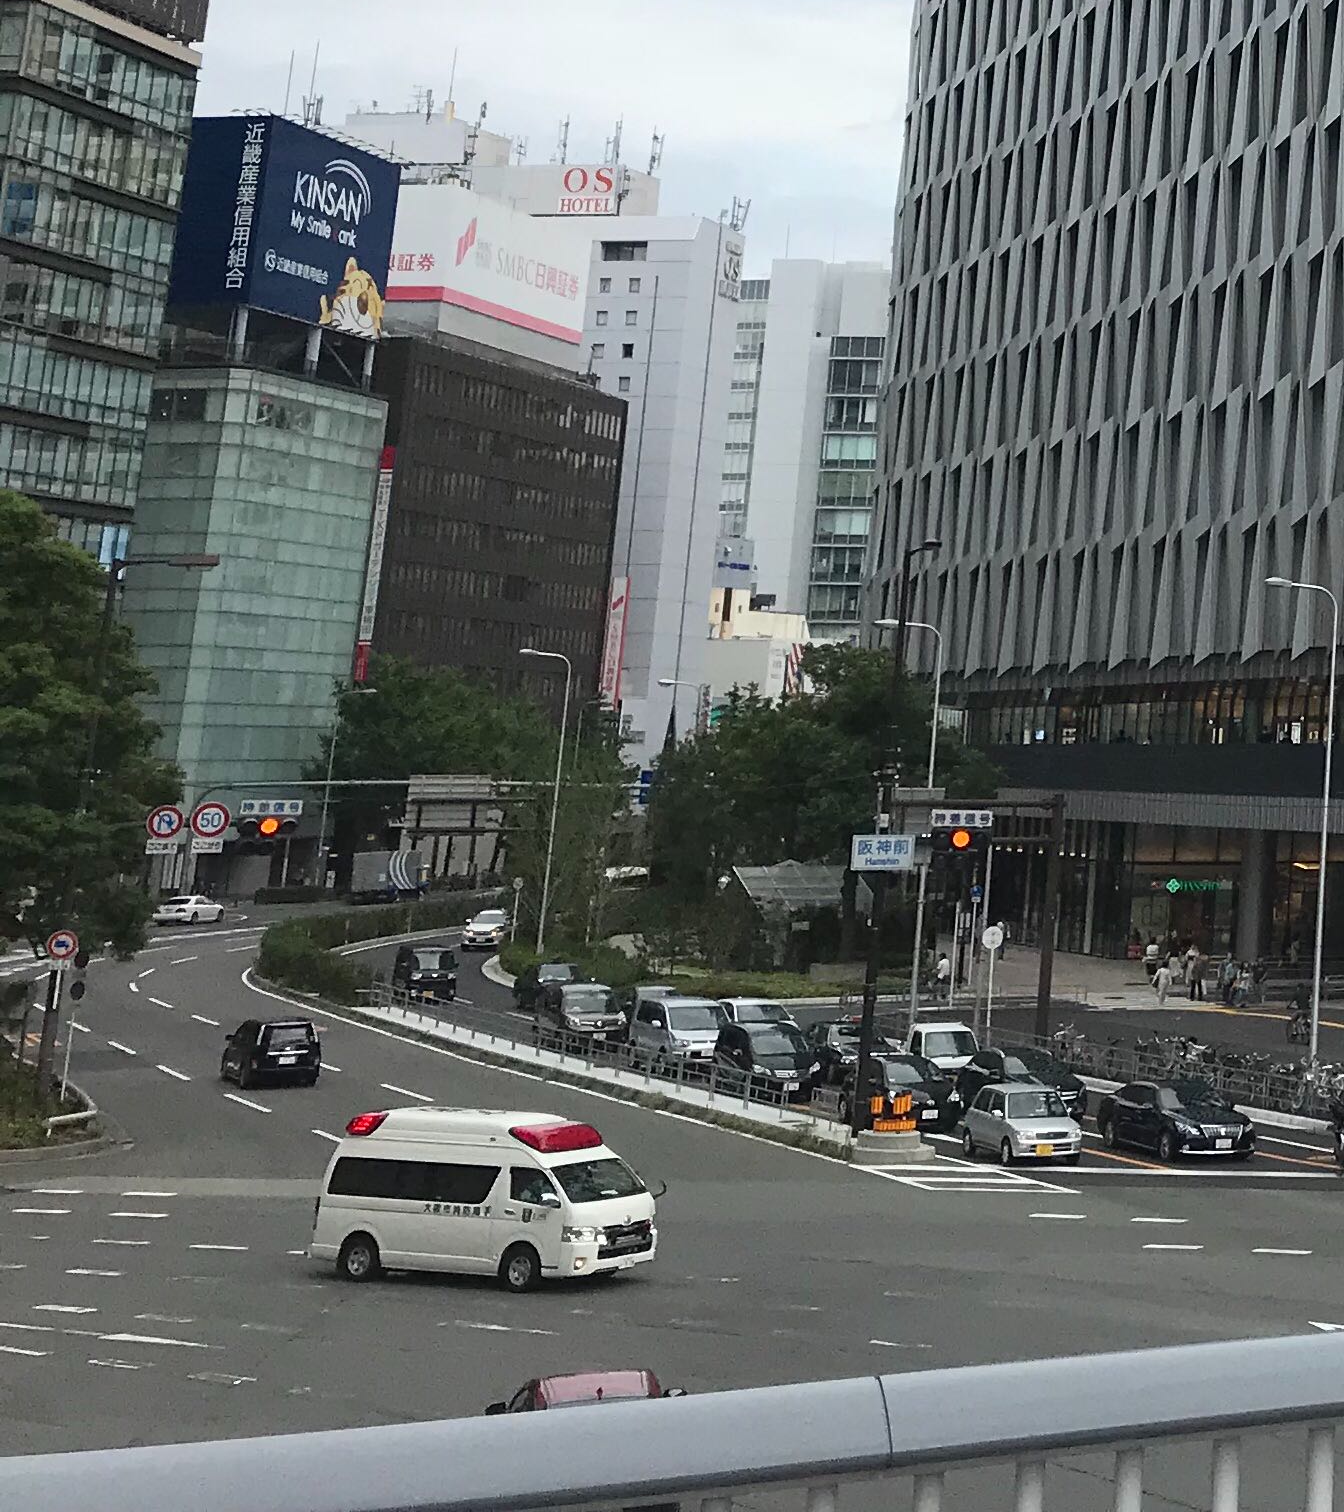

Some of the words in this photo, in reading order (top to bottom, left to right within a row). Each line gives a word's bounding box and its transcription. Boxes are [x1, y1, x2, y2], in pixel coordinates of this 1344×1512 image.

[563, 167, 614, 193] OS
[226, 123, 266, 289] 近畿産業信用組合
[293, 171, 363, 225] KINSAN
[559, 198, 612, 213] HOTEL
[291, 209, 306, 234] My
[306, 215, 332, 239] Smile
[495, 247, 580, 301] SMBC日興証券
[201, 812, 222, 828] 50
[857, 839, 910, 856] 阪神前
